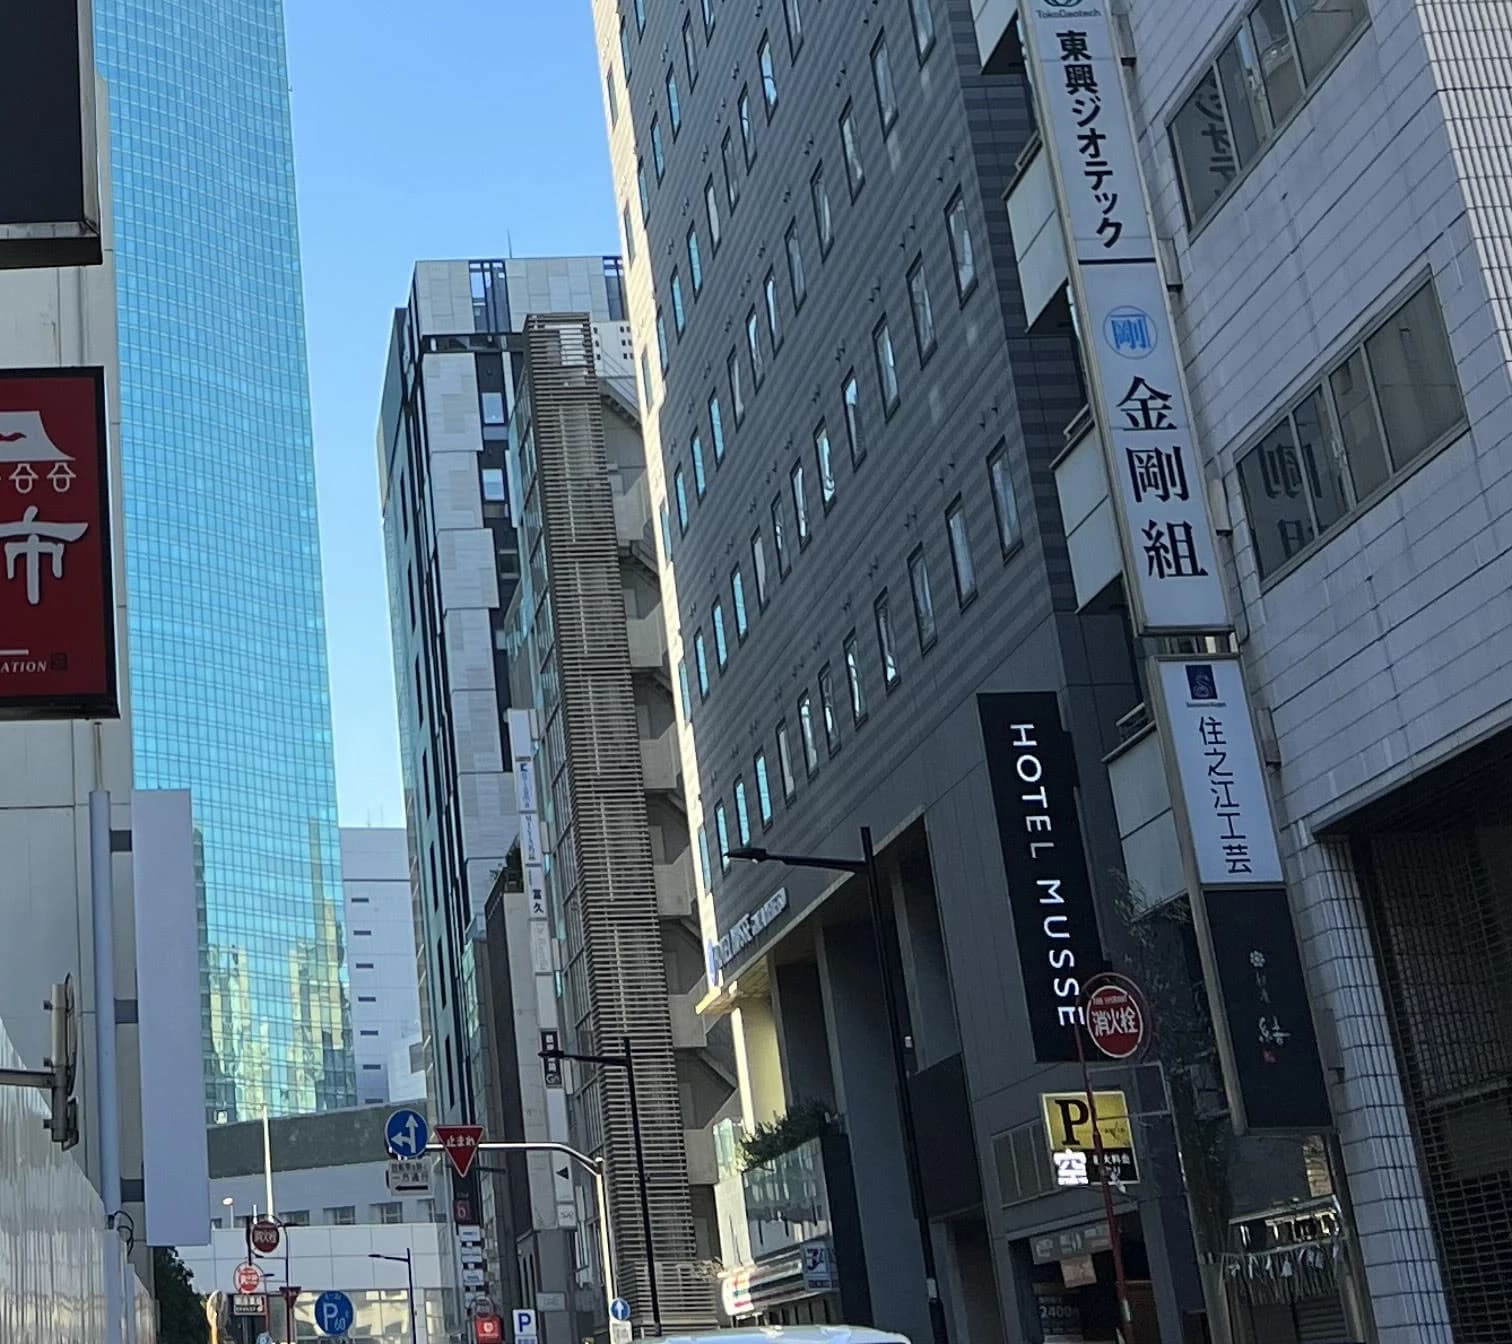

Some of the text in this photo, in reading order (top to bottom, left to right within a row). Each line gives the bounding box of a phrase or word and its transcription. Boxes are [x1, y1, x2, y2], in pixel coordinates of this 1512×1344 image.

[1056, 30, 1123, 249] 東興ジオテック
[1116, 376, 1209, 580] 金剛組
[1199, 716, 1252, 874] 住之江工芸
[1009, 723, 1086, 1027] HOTEL MUSSE
[1091, 1006, 1139, 1037] 消火栓
[446, 1135, 477, 1148] 止まれ
[1054, 1099, 1089, 1146] P
[323, 1303, 338, 1331] P
[518, 1313, 532, 1333] P
